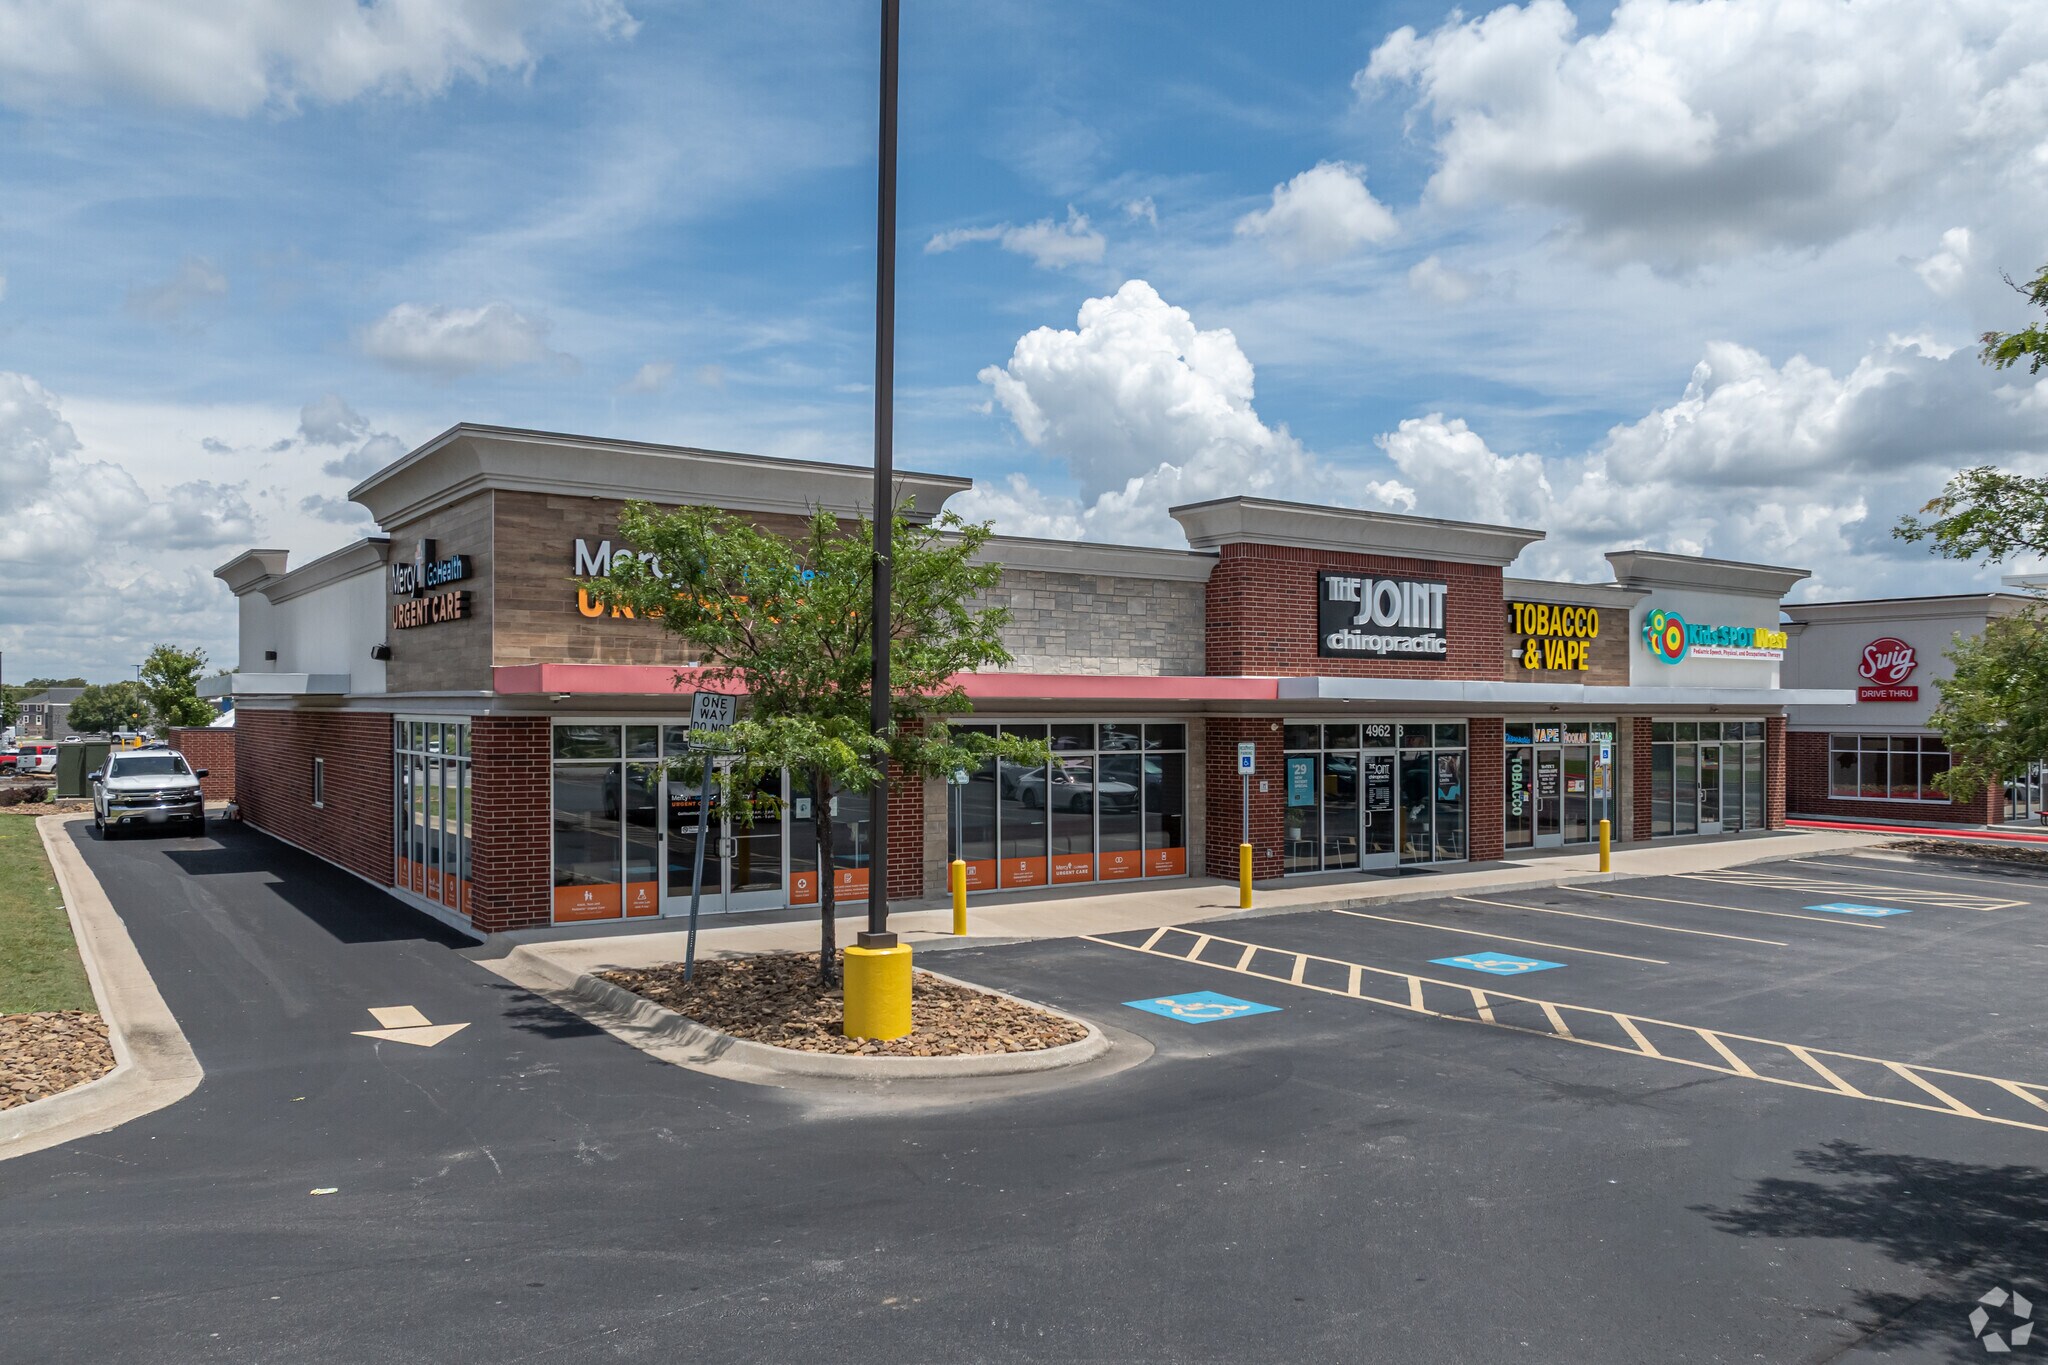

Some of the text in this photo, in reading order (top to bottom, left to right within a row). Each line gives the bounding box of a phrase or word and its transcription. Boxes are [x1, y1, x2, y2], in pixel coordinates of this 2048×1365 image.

[392, 554, 462, 598] Mercy GoHealth
[392, 590, 461, 629] URGENT CARE
[1325, 576, 1447, 629] THE JOINT
[1513, 603, 1599, 638] TOBACCO
[1326, 628, 1447, 655] chiropractic
[1754, 627, 1788, 649] West
[1524, 638, 1590, 671] & VAPE
[1859, 645, 1916, 679] Swig
[702, 696, 728, 709] ONE
[1861, 690, 1887, 698] DRIVE
[693, 721, 707, 731] DO
[700, 708, 727, 721] WAY
[1365, 724, 1391, 737] 4962
[1535, 728, 1559, 742] VAPE
[1511, 756, 1523, 816] TOBACCO
